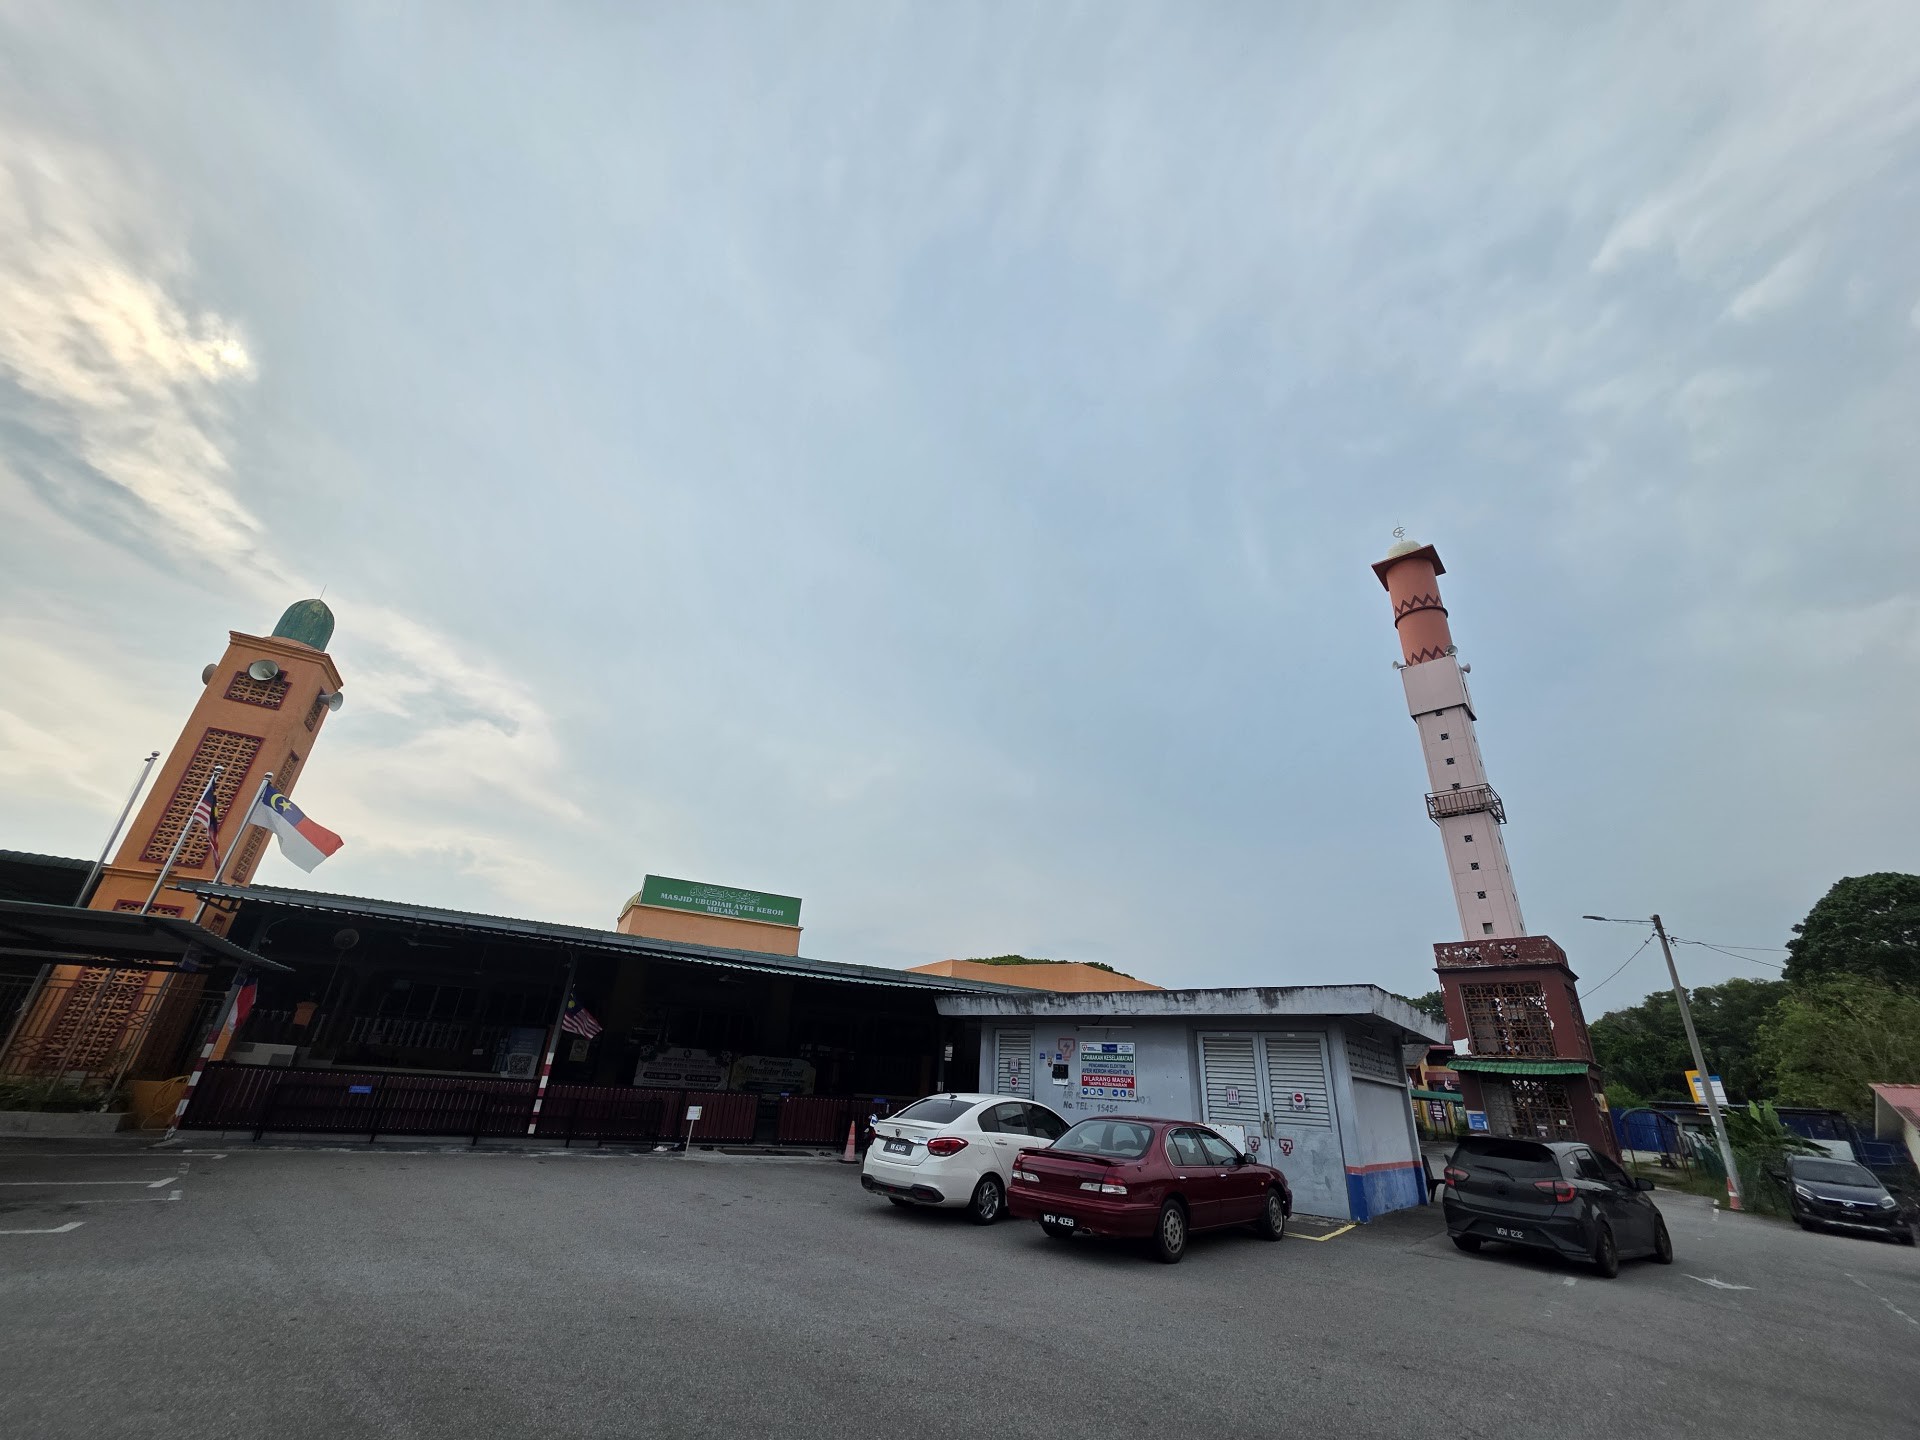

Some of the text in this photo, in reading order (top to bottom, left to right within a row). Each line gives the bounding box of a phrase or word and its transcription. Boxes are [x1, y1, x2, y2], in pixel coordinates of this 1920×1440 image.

[660, 893, 692, 903] MASJID
[695, 897, 732, 908] UBUDIAH
[733, 903, 754, 912] AYER
[756, 906, 784, 917] KEROH
[706, 905, 739, 916] MELAKA
[1083, 1075, 1111, 1083] DILARANG
